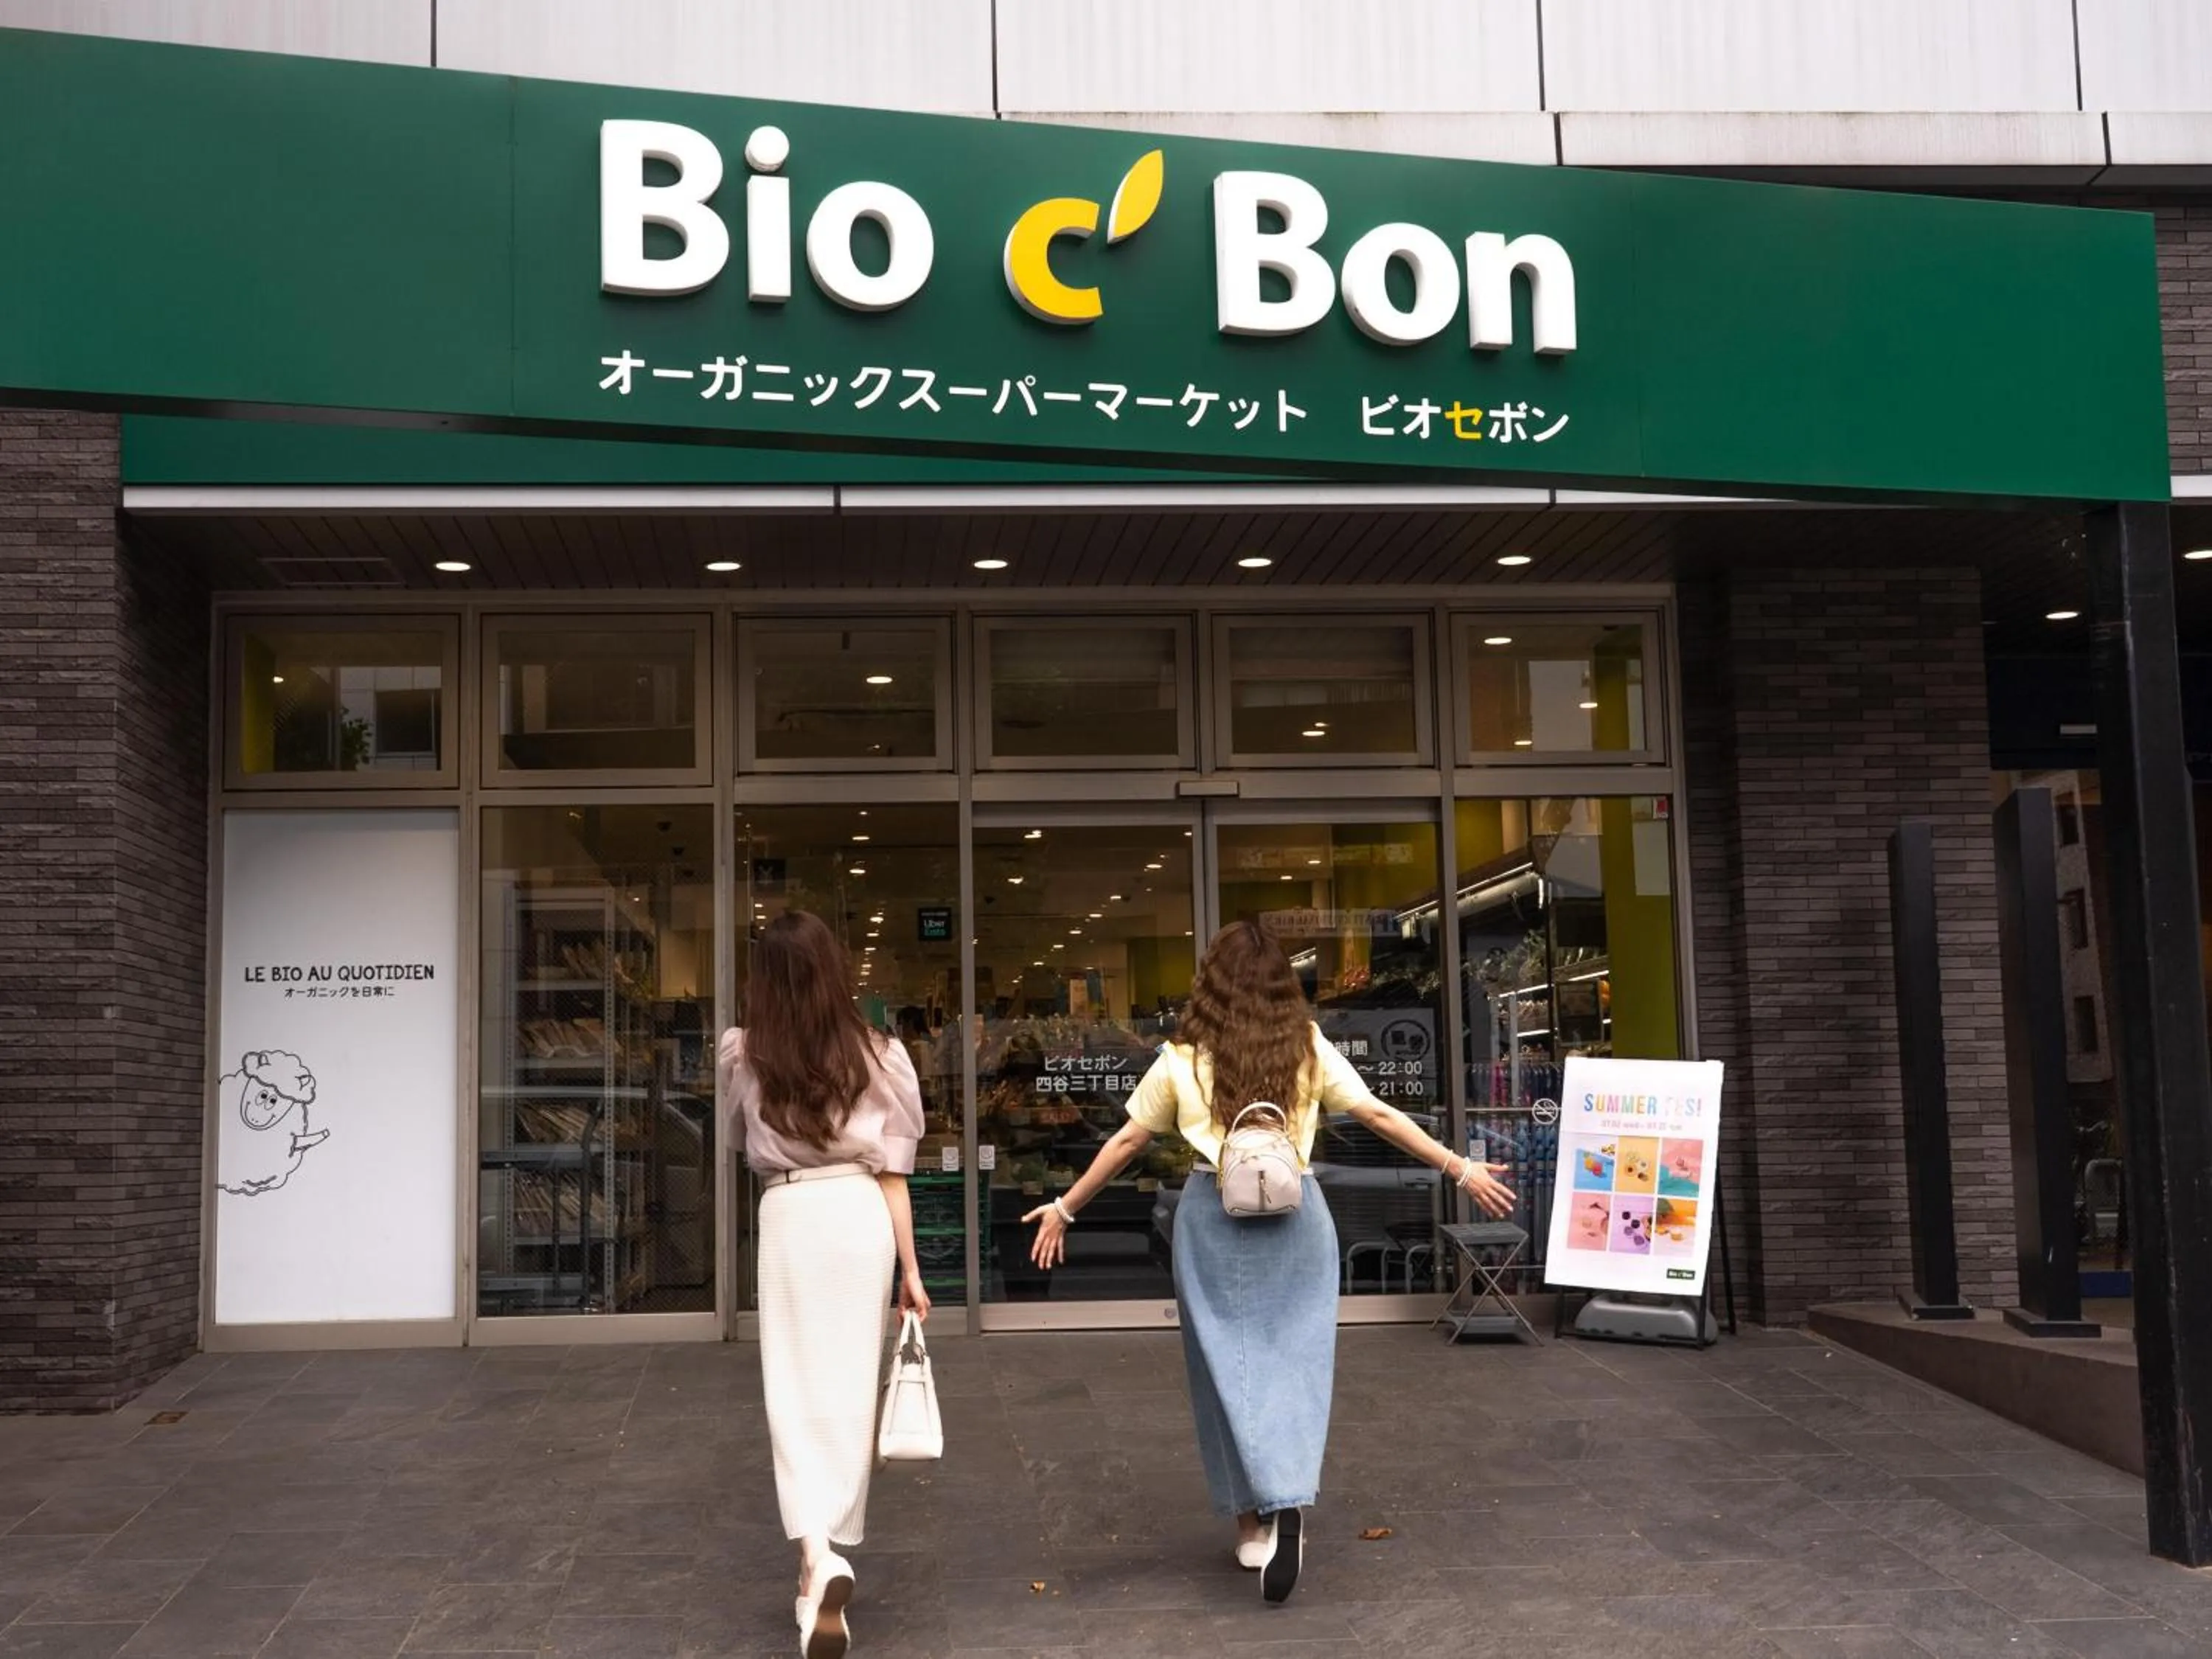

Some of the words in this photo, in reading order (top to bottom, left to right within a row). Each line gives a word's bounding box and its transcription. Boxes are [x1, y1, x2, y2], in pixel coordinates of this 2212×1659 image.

[600, 119, 934, 311] Bio
[1213, 170, 1577, 355] Bon
[599, 349, 1307, 432] オーガニックスーパーマーケット
[1361, 394, 1570, 442] ビオセボン
[244, 967, 266, 982] LE
[271, 966, 303, 982] BIO
[307, 965, 333, 981] AU
[337, 964, 435, 982] QUOTIDIEN
[284, 985, 396, 998] オーガニックを日常に
[1044, 1054, 1129, 1071] ビオセボン
[1035, 1074, 1138, 1092] 四谷三丁目店
[1583, 1093, 1658, 1116] SUMMER
